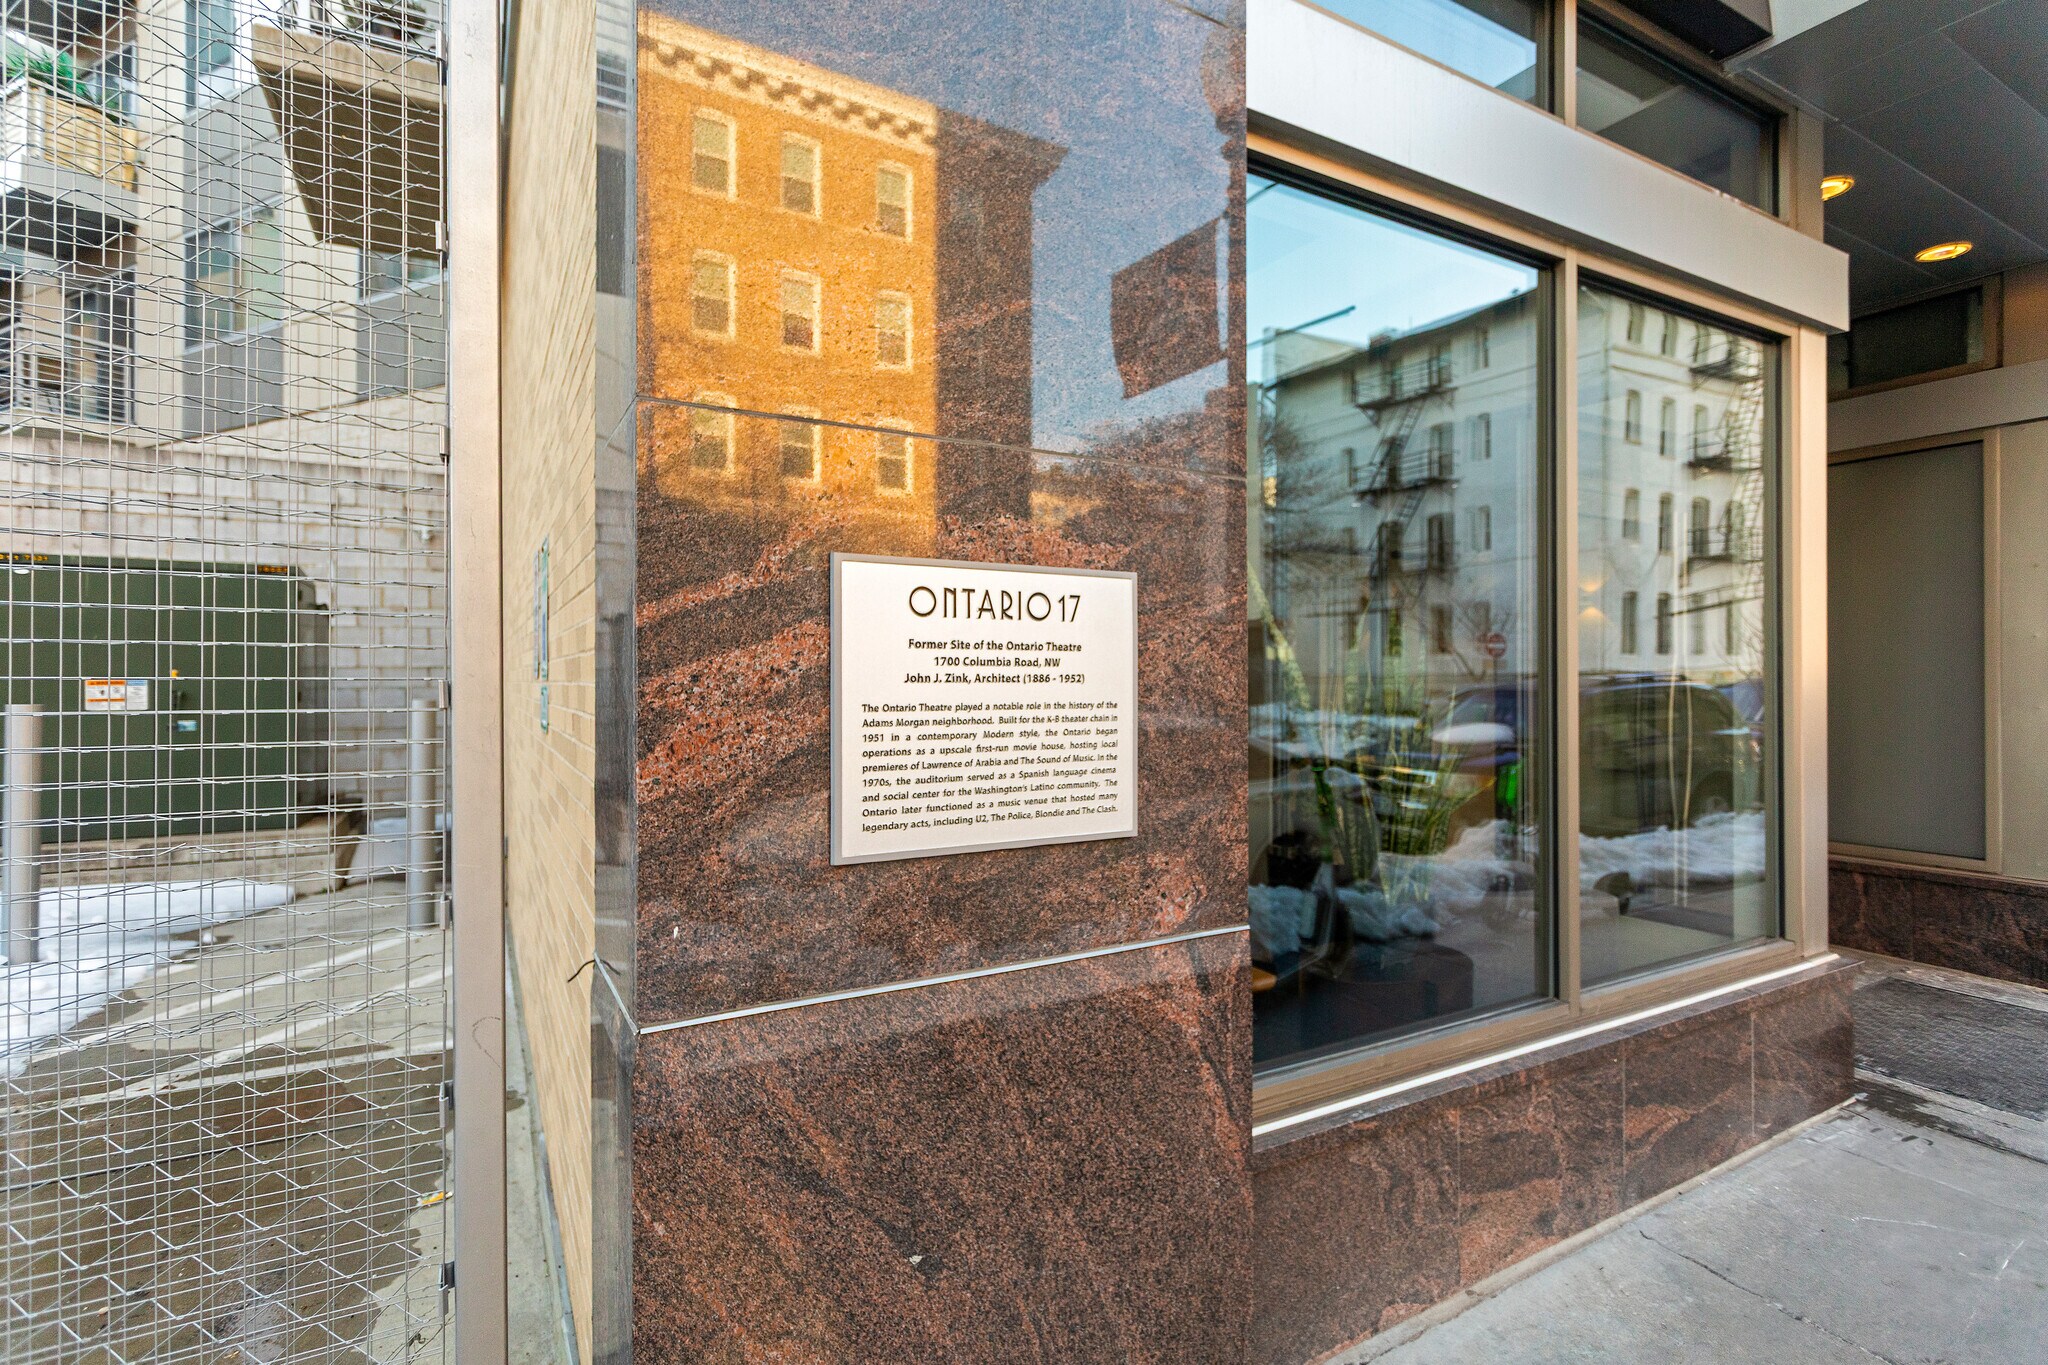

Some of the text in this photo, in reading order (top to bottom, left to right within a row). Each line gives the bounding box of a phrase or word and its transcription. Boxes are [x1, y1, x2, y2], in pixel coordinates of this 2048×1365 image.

[908, 638, 1082, 652] Former Site of the Ontario Theatre
[933, 656, 1061, 669] 1700 Columbia Road, NW
[903, 672, 931, 684] John
[933, 673, 943, 684] J.
[944, 672, 972, 685] Zink,
[973, 673, 1021, 684] Architect
[1023, 673, 1051, 685] (1886
[1058, 673, 1085, 685] 1952)
[861, 700, 1118, 713] The Ontario Theatre played a notable role in the history of the
[861, 718, 894, 728] Adams
[895, 718, 930, 729] Morgan
[931, 716, 995, 728] neighborhood.
[998, 715, 1018, 725] Built
[1018, 715, 1031, 724] for
[1031, 715, 1046, 724] the
[1060, 714, 1089, 723] theater
[1089, 714, 1110, 722] chain
[1110, 714, 1118, 722] in
[862, 727, 1118, 743] 1951 in a contemporary Modern style, the Ontario began
[861, 747, 912, 760] operations
[915, 748, 926, 756] as
[939, 744, 972, 757] upscale
[975, 743, 1009, 753] first-run
[1012, 742, 1038, 752] movie
[1040, 742, 1066, 751] house,
[1069, 741, 1098, 751] hosting
[1100, 739, 1118, 748] local
[862, 753, 1118, 775] premieres of Lawrence of Arabia and The Sound of Music. In the
[862, 778, 892, 788] 1970s,
[895, 776, 912, 786] the
[914, 774, 964, 785] auditorium
[966, 771, 995, 782] served
[997, 772, 1007, 780] as
[1018, 769, 1050, 780] Spanish
[1052, 768, 1088, 778] language
[1090, 766, 1117, 775] cinema
[861, 778, 1118, 803] and social center for the Washington's Latino community. The
[862, 806, 898, 818] Ontario
[901, 805, 923, 815] later
[925, 801, 973, 813] functioned
[997, 798, 1021, 808] music
[1023, 797, 1048, 806] venue
[1051, 795, 1067, 804] that
[1070, 793, 1096, 802] hosted
[1098, 793, 1118, 801] many
[862, 804, 1118, 834] legendary acts, including U2, The Police, Blondie and The Clash.
